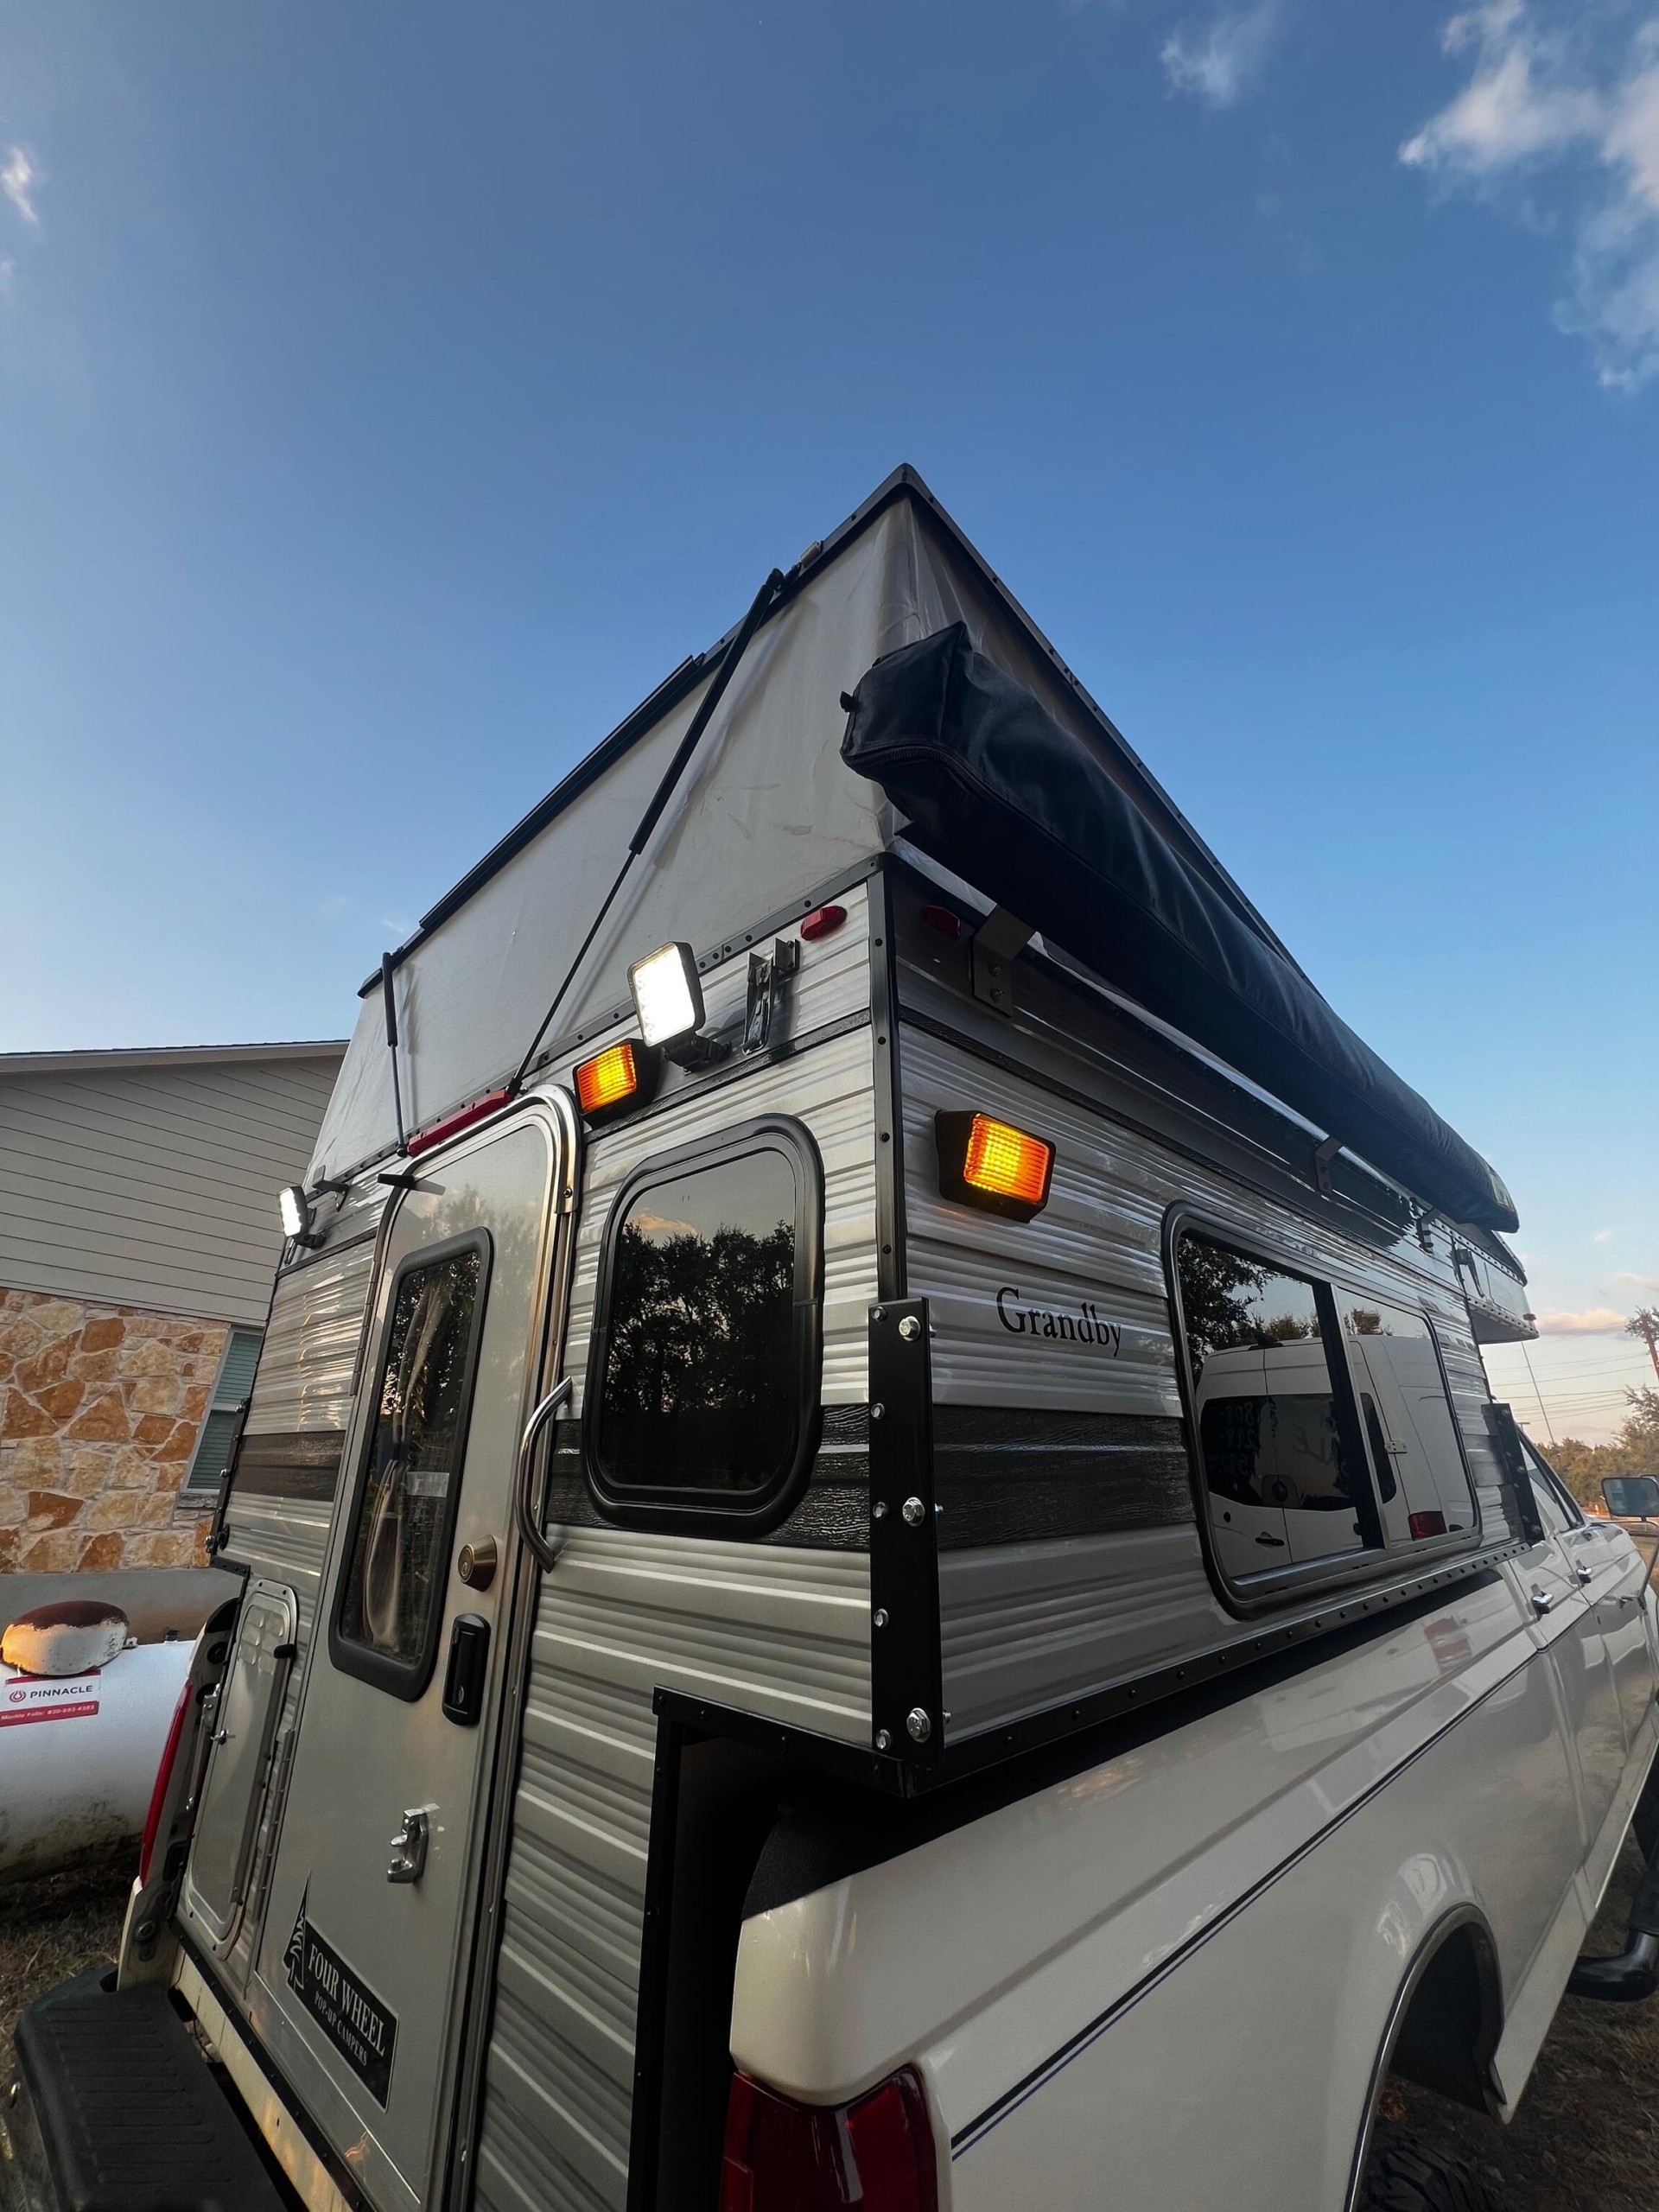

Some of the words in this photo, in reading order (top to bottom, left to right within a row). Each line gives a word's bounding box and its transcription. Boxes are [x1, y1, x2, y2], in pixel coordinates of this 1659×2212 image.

[996, 1287, 1122, 1357] Grandby
[30, 1685, 92, 1698] PINNACLE
[308, 1942, 339, 2002] FOUR
[341, 1977, 385, 2057] WHEEL
[314, 1990, 337, 2030] POP-UP
[337, 2018, 368, 2068] CAMPERS
